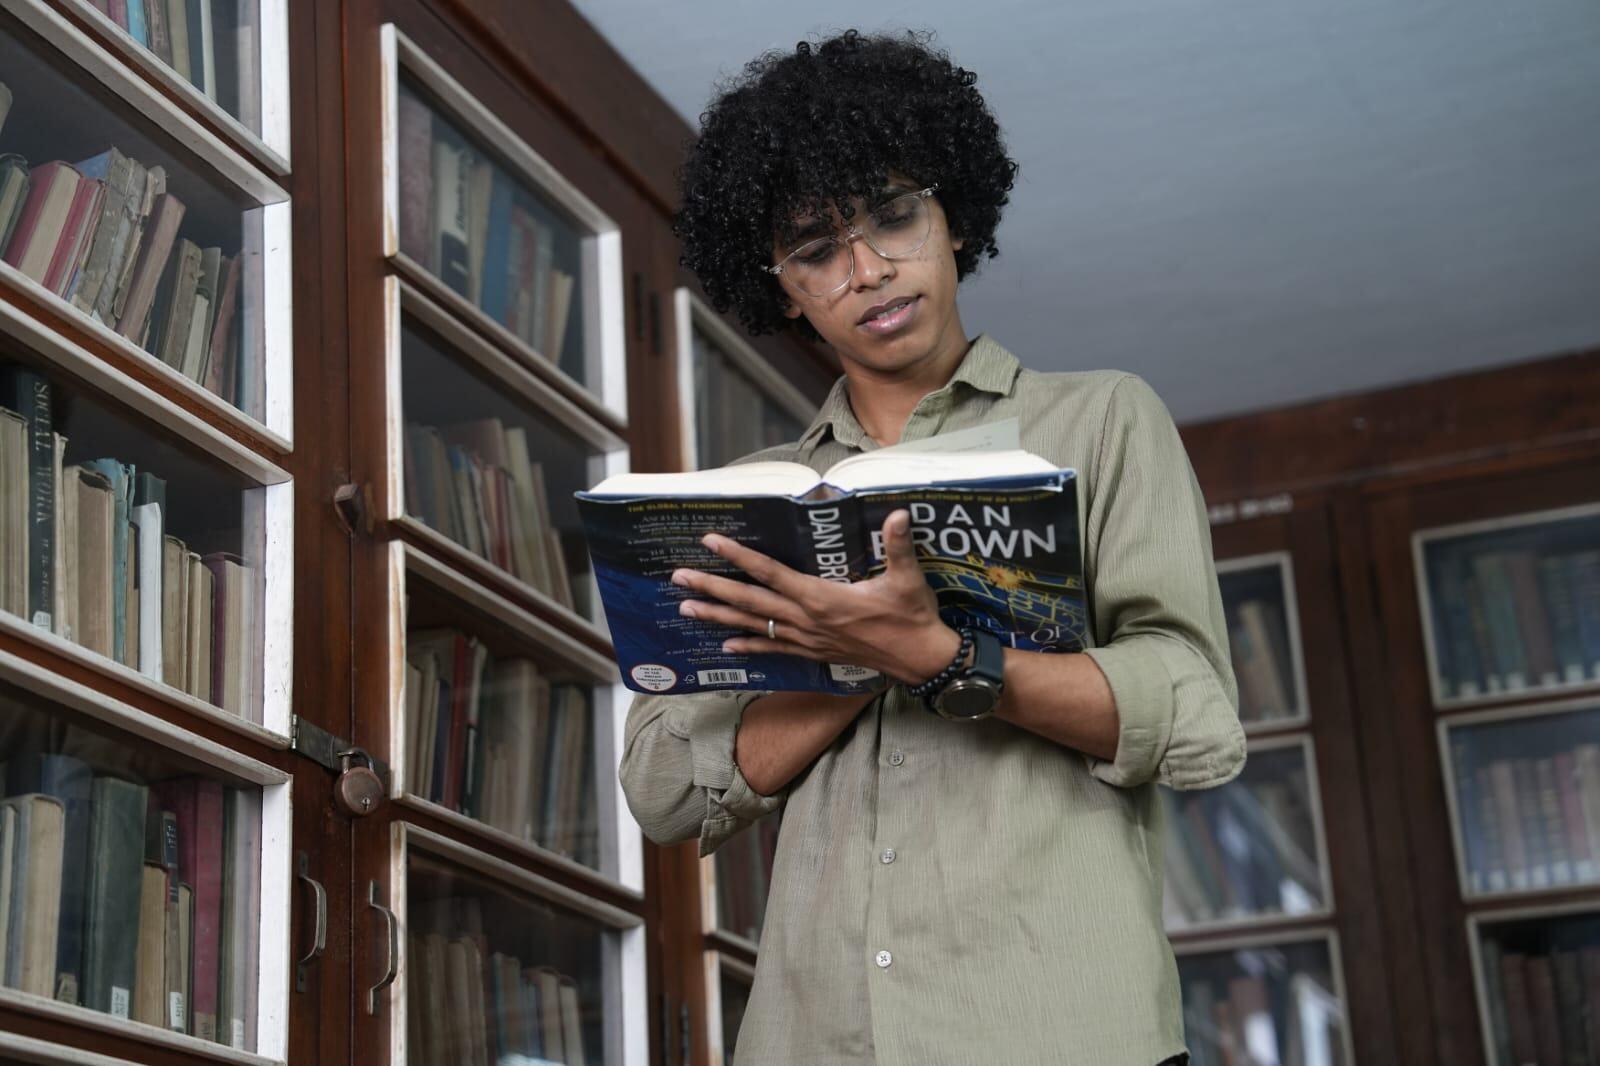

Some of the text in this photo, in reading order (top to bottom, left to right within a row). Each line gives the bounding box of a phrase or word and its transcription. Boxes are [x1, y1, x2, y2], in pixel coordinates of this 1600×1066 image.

[909, 502, 1012, 527] DAN
[808, 506, 851, 584] DAN BR
